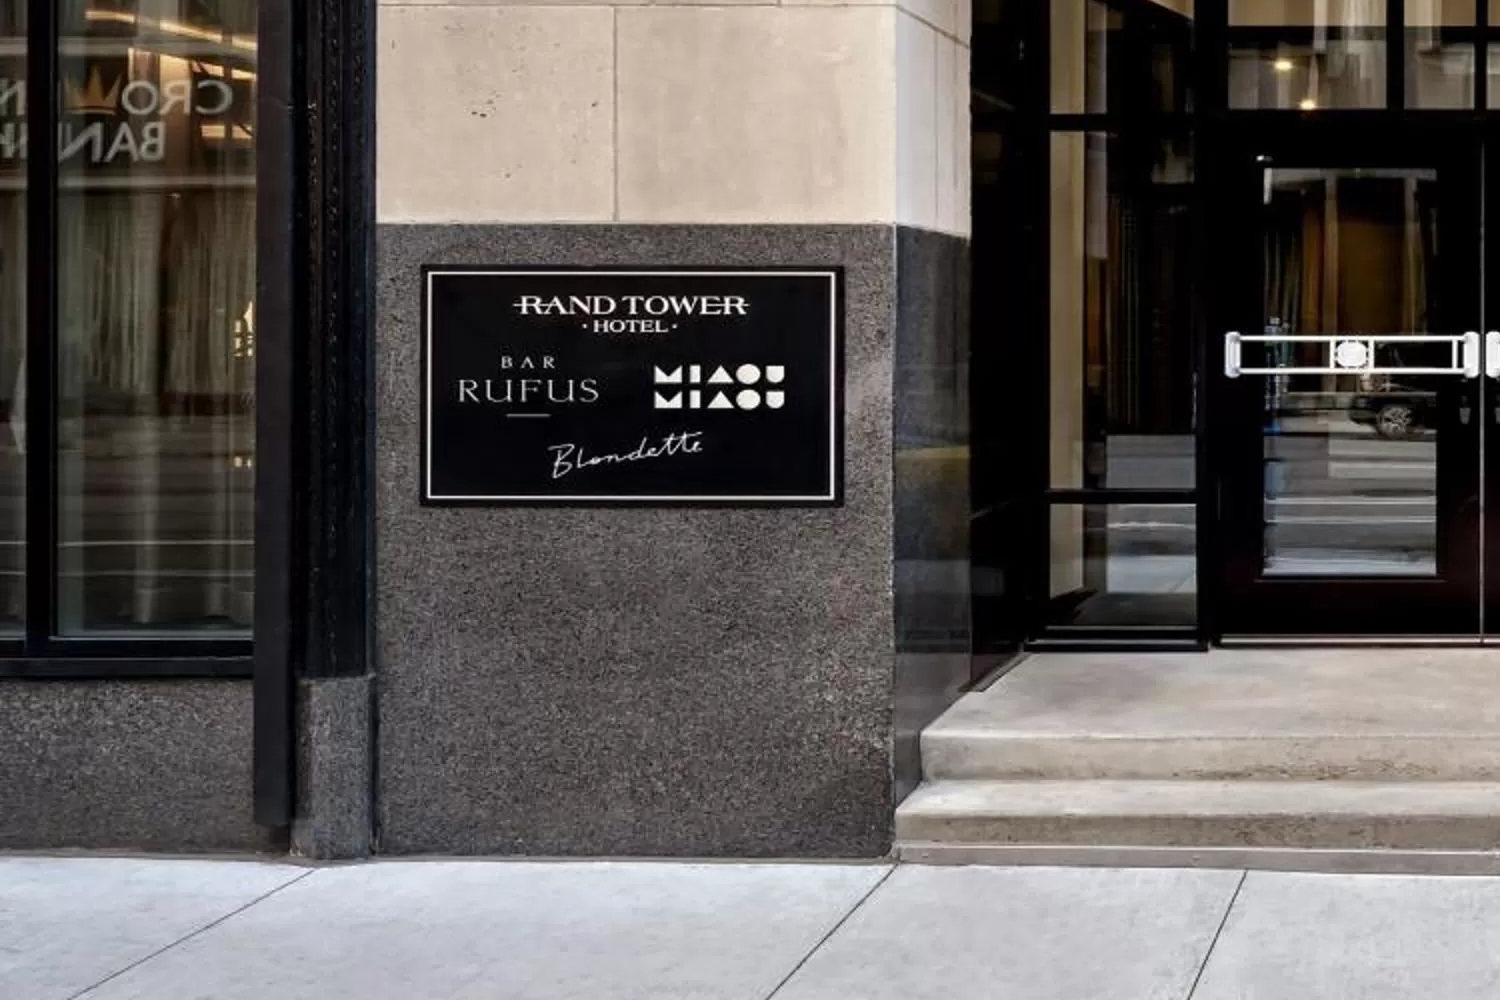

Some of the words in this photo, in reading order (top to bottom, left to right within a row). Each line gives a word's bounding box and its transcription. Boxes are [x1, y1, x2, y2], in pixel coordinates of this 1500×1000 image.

[517, 295, 617, 316] RAND
[621, 295, 748, 316] TOWER
[593, 319, 669, 333] HOTEL
[501, 355, 556, 370] BAR
[653, 363, 785, 385] MIAOU
[458, 379, 600, 403] RUFUS
[653, 388, 785, 411] MIAOU
[548, 431, 703, 479] Blondette
